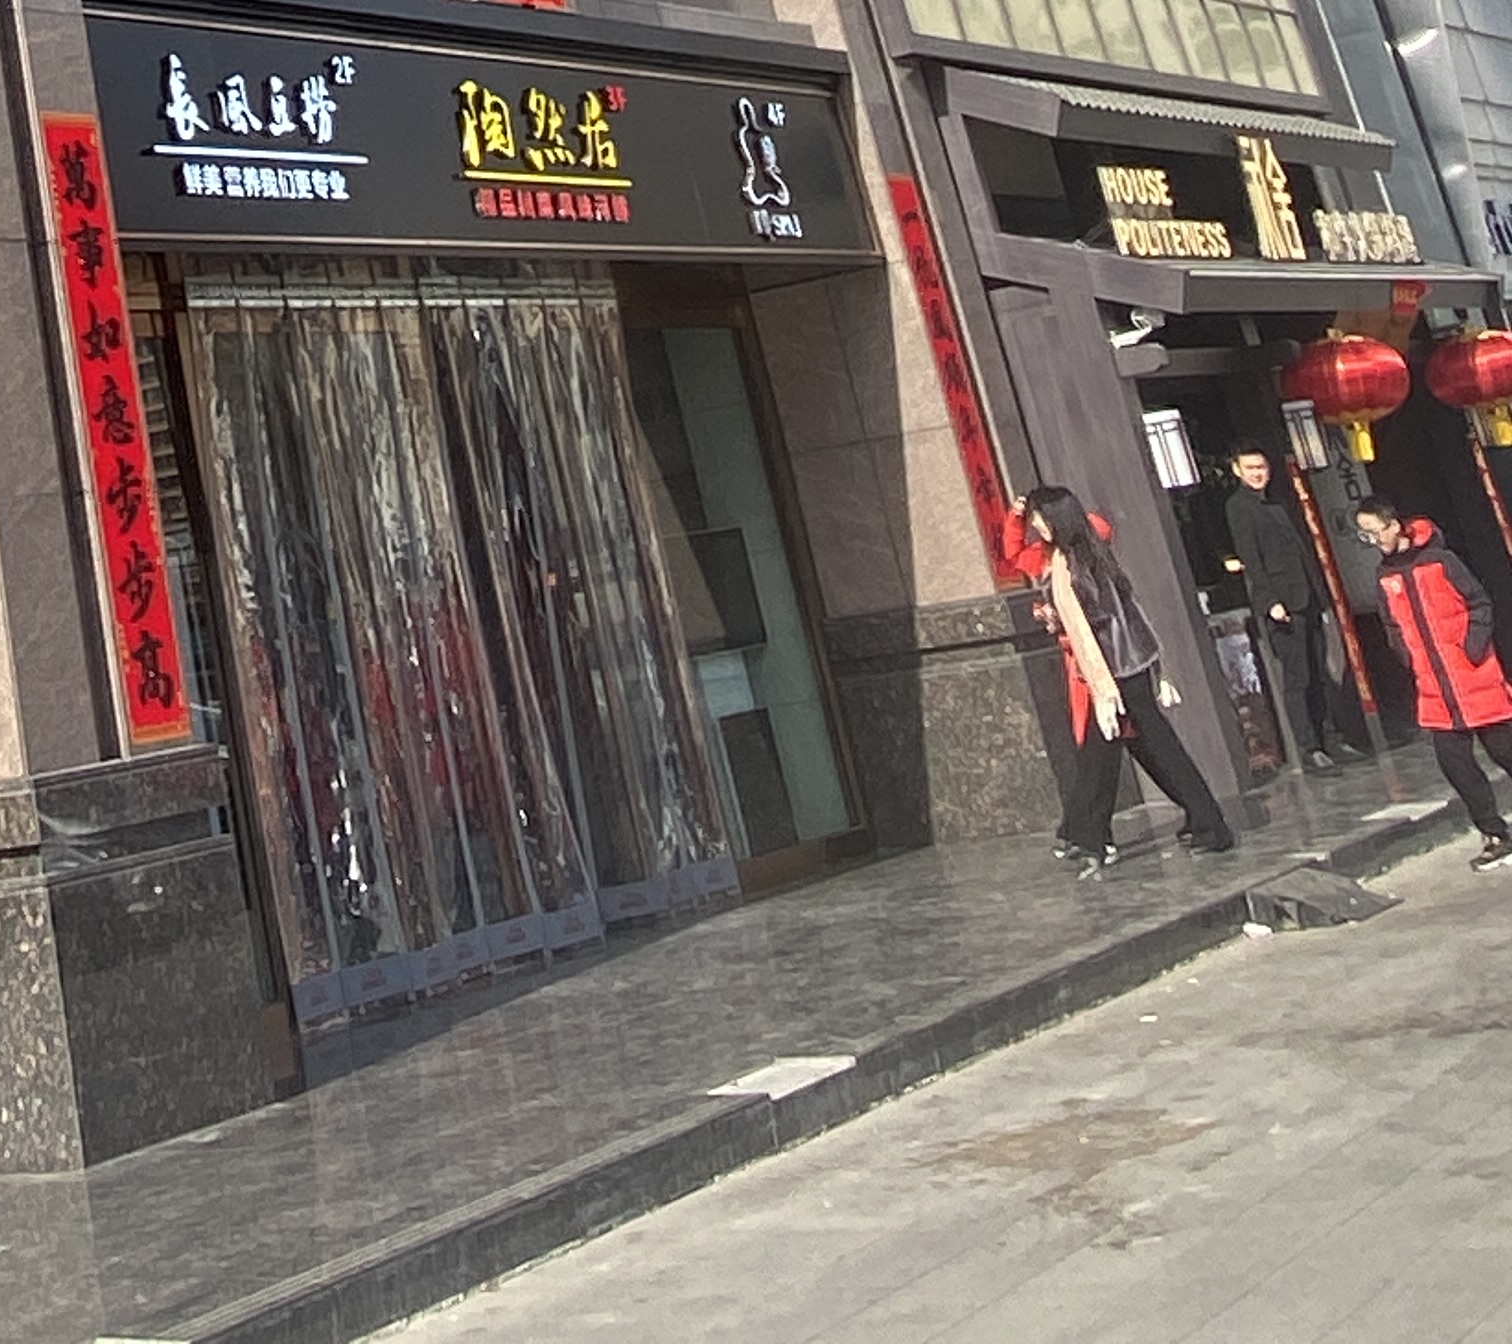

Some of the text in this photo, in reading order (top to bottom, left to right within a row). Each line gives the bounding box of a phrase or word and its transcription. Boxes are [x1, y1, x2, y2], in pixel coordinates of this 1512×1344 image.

[331, 56, 356, 85] 2F
[460, 80, 618, 172] 陶然居
[1096, 166, 1174, 207] HOUSE
[1111, 218, 1232, 259] POLITENESS
